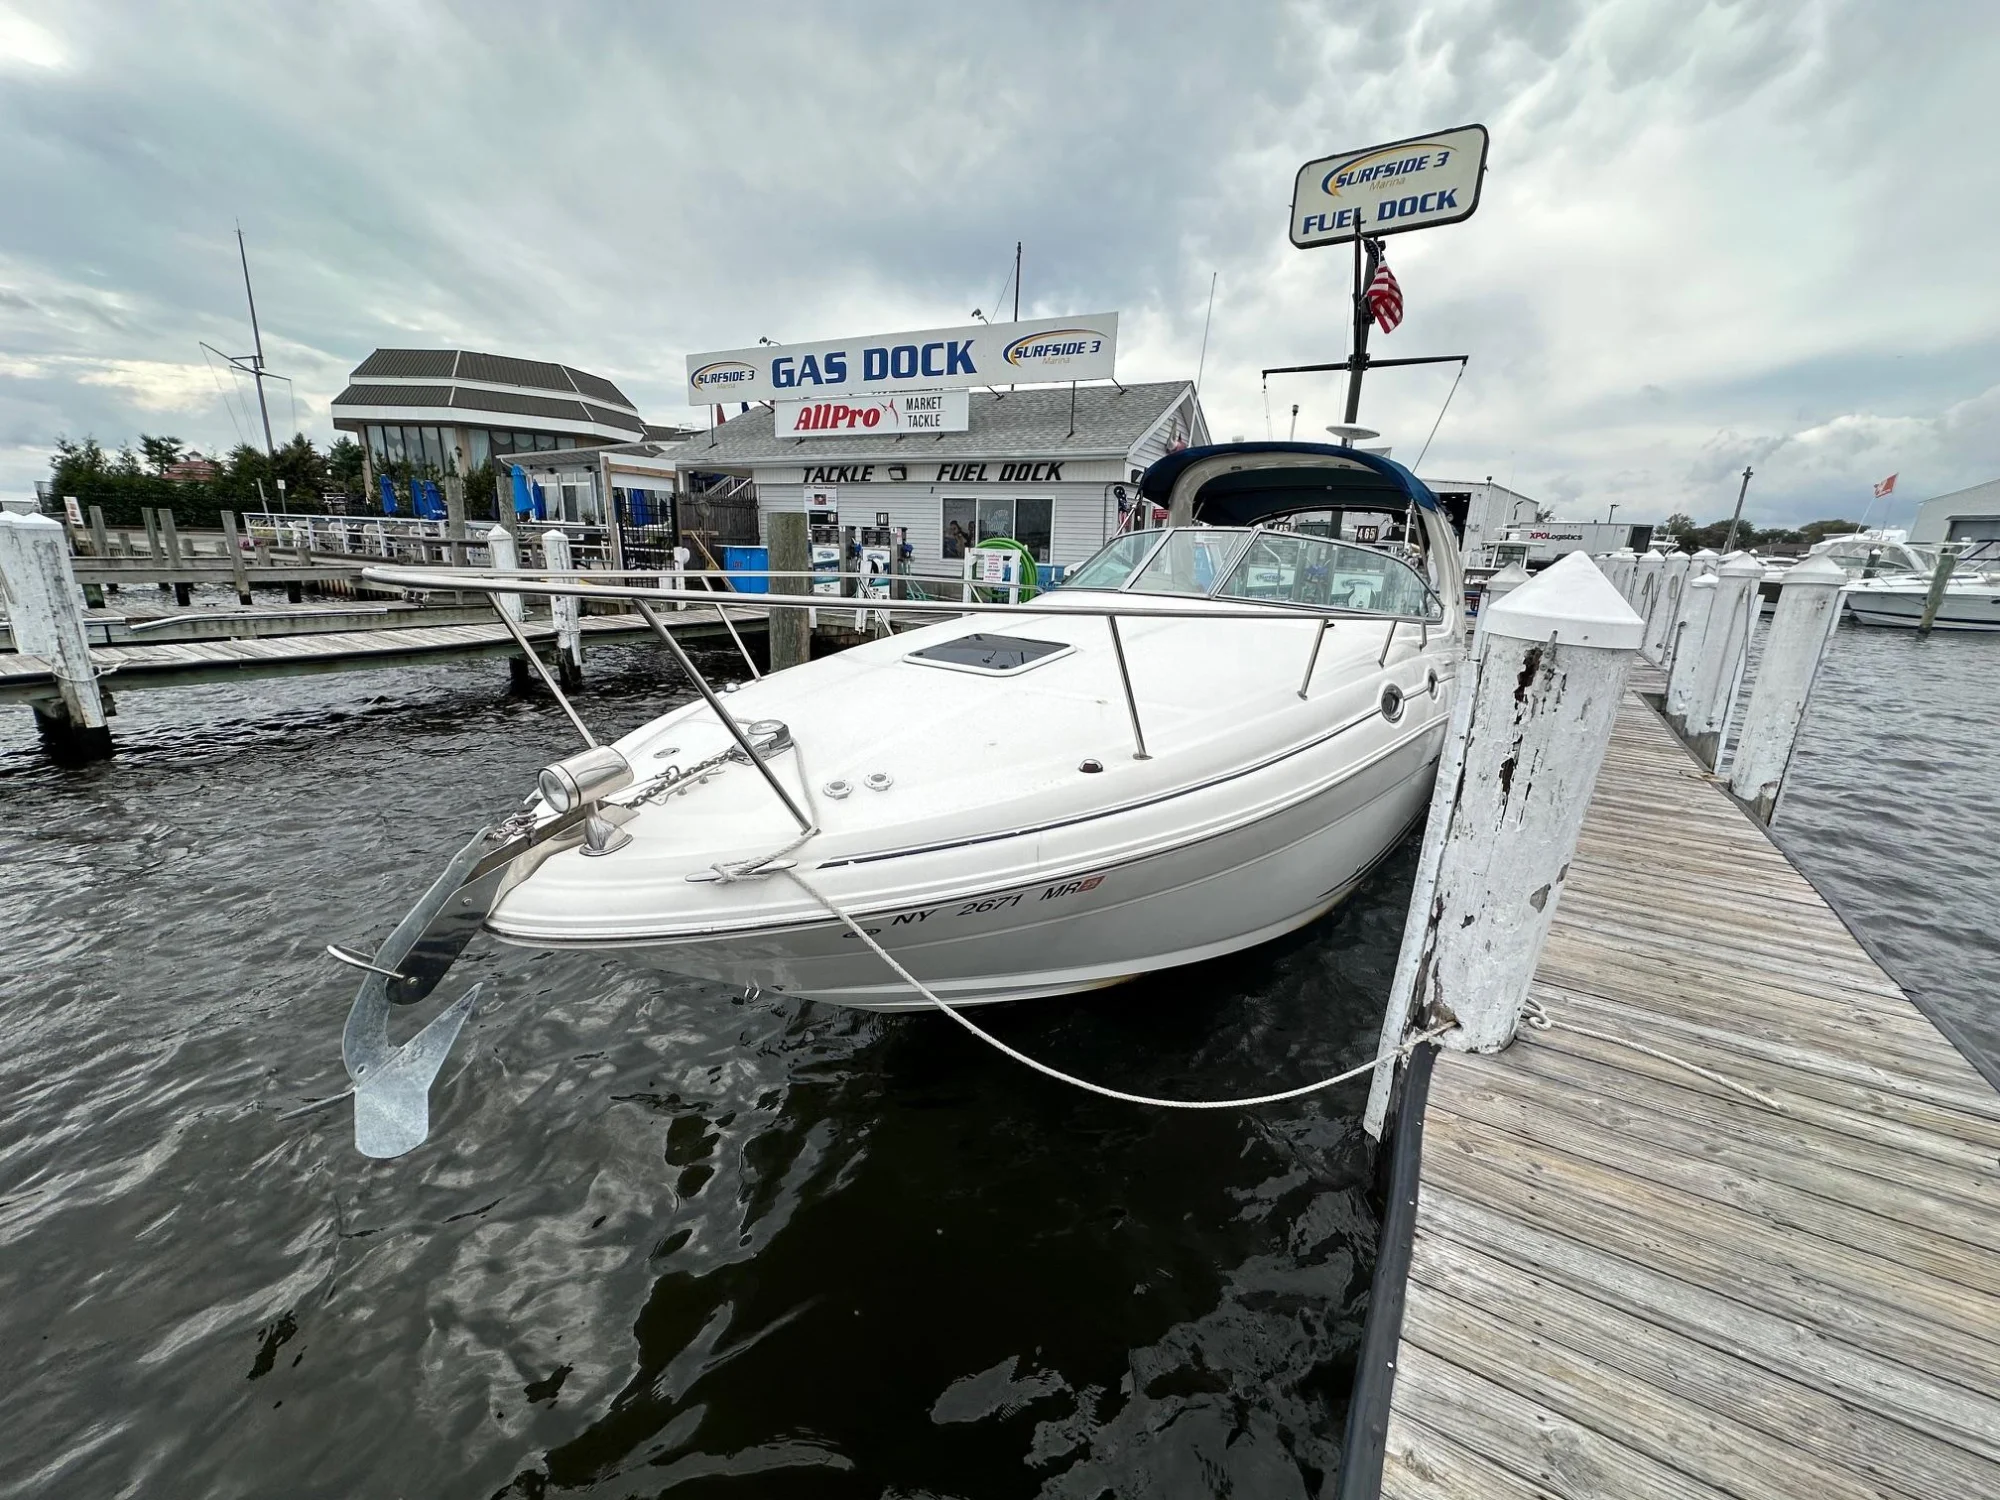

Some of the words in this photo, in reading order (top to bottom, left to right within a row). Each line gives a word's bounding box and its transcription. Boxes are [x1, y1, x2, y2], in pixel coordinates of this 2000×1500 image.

[1335, 155, 1430, 188] SURFSIDE
[1433, 151, 1450, 168] 3
[1369, 176, 1406, 191] Marina
[1302, 206, 1367, 235] FUEL
[1377, 187, 1458, 221] DOCK
[1012, 341, 1086, 361] SURFSIDE
[1089, 339, 1101, 353] 3
[771, 351, 848, 388] GAS
[863, 339, 978, 381] DOCK
[1042, 357, 1070, 365] Marina
[698, 371, 745, 384] SURFSIDE
[747, 370, 755, 380] 3
[906, 396, 942, 411] MARKET
[793, 403, 881, 431] AllPro
[908, 413, 941, 428] TACKLE
[803, 465, 875, 483] TACKLE
[936, 463, 988, 482] FUEL
[998, 462, 1064, 482] DOCK
[891, 908, 938, 926] NY
[957, 894, 1024, 916] 2671
[1039, 880, 1083, 901] MR
